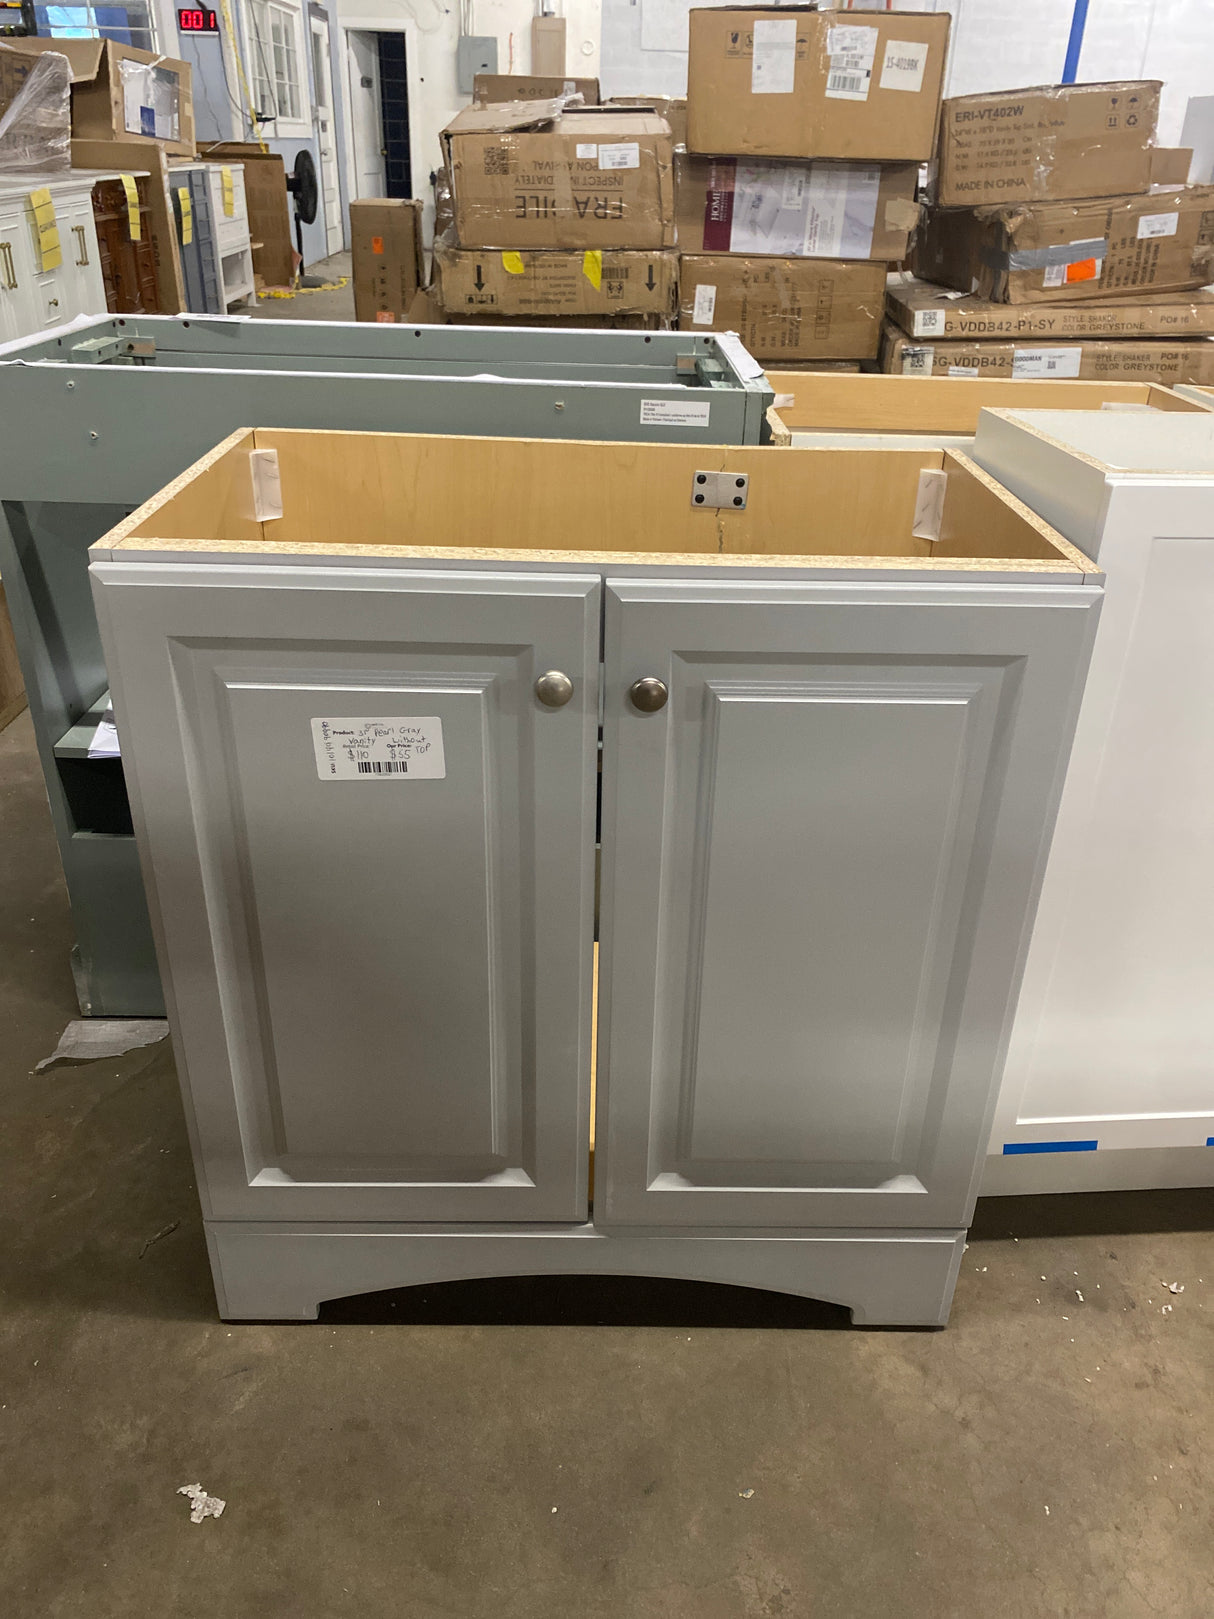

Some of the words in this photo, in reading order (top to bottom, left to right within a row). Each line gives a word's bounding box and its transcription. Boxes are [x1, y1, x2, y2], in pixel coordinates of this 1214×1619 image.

[955, 105, 1024, 123] ERI-VT402W
[582, 176, 624, 186] INSPECT
[955, 181, 982, 191] MADE
[983, 180, 994, 189] IN
[996, 178, 1026, 189] CHINA
[1089, 322, 1145, 331] GREYSTONE
[1123, 362, 1179, 372] GREYSTONE
[374, 727, 395, 737] Pearl
[399, 726, 421, 736] Gray
